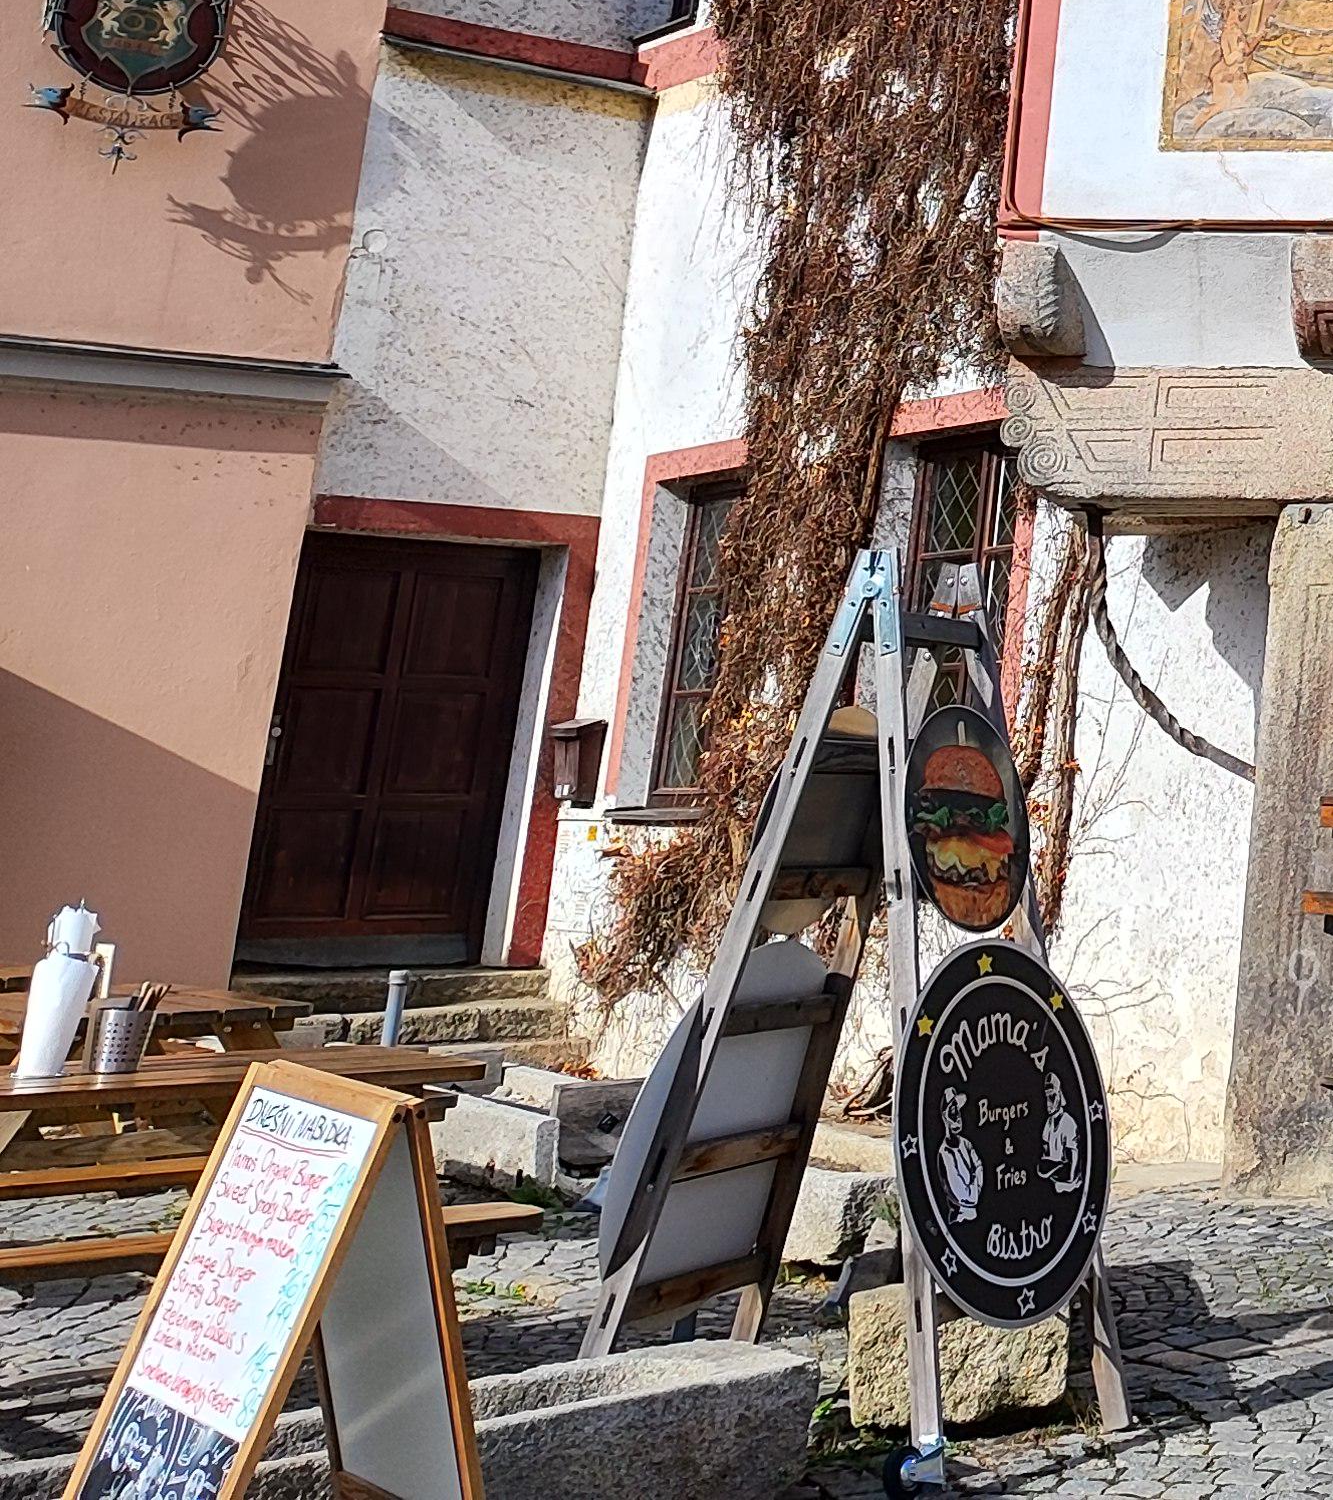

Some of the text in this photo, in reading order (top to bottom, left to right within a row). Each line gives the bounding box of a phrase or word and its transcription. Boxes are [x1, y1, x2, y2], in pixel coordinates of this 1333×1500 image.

[940, 1012, 1050, 1082] Mama's
[978, 1098, 1029, 1130] Burgers
[1004, 1137, 1014, 1155] &
[285, 1159, 328, 1204] Burger
[995, 1162, 1027, 1191] Fries
[276, 1191, 313, 1239] Burger
[986, 1214, 1053, 1260] Bistro
[212, 1246, 256, 1292] Burger
[204, 1278, 241, 1326] Burger
